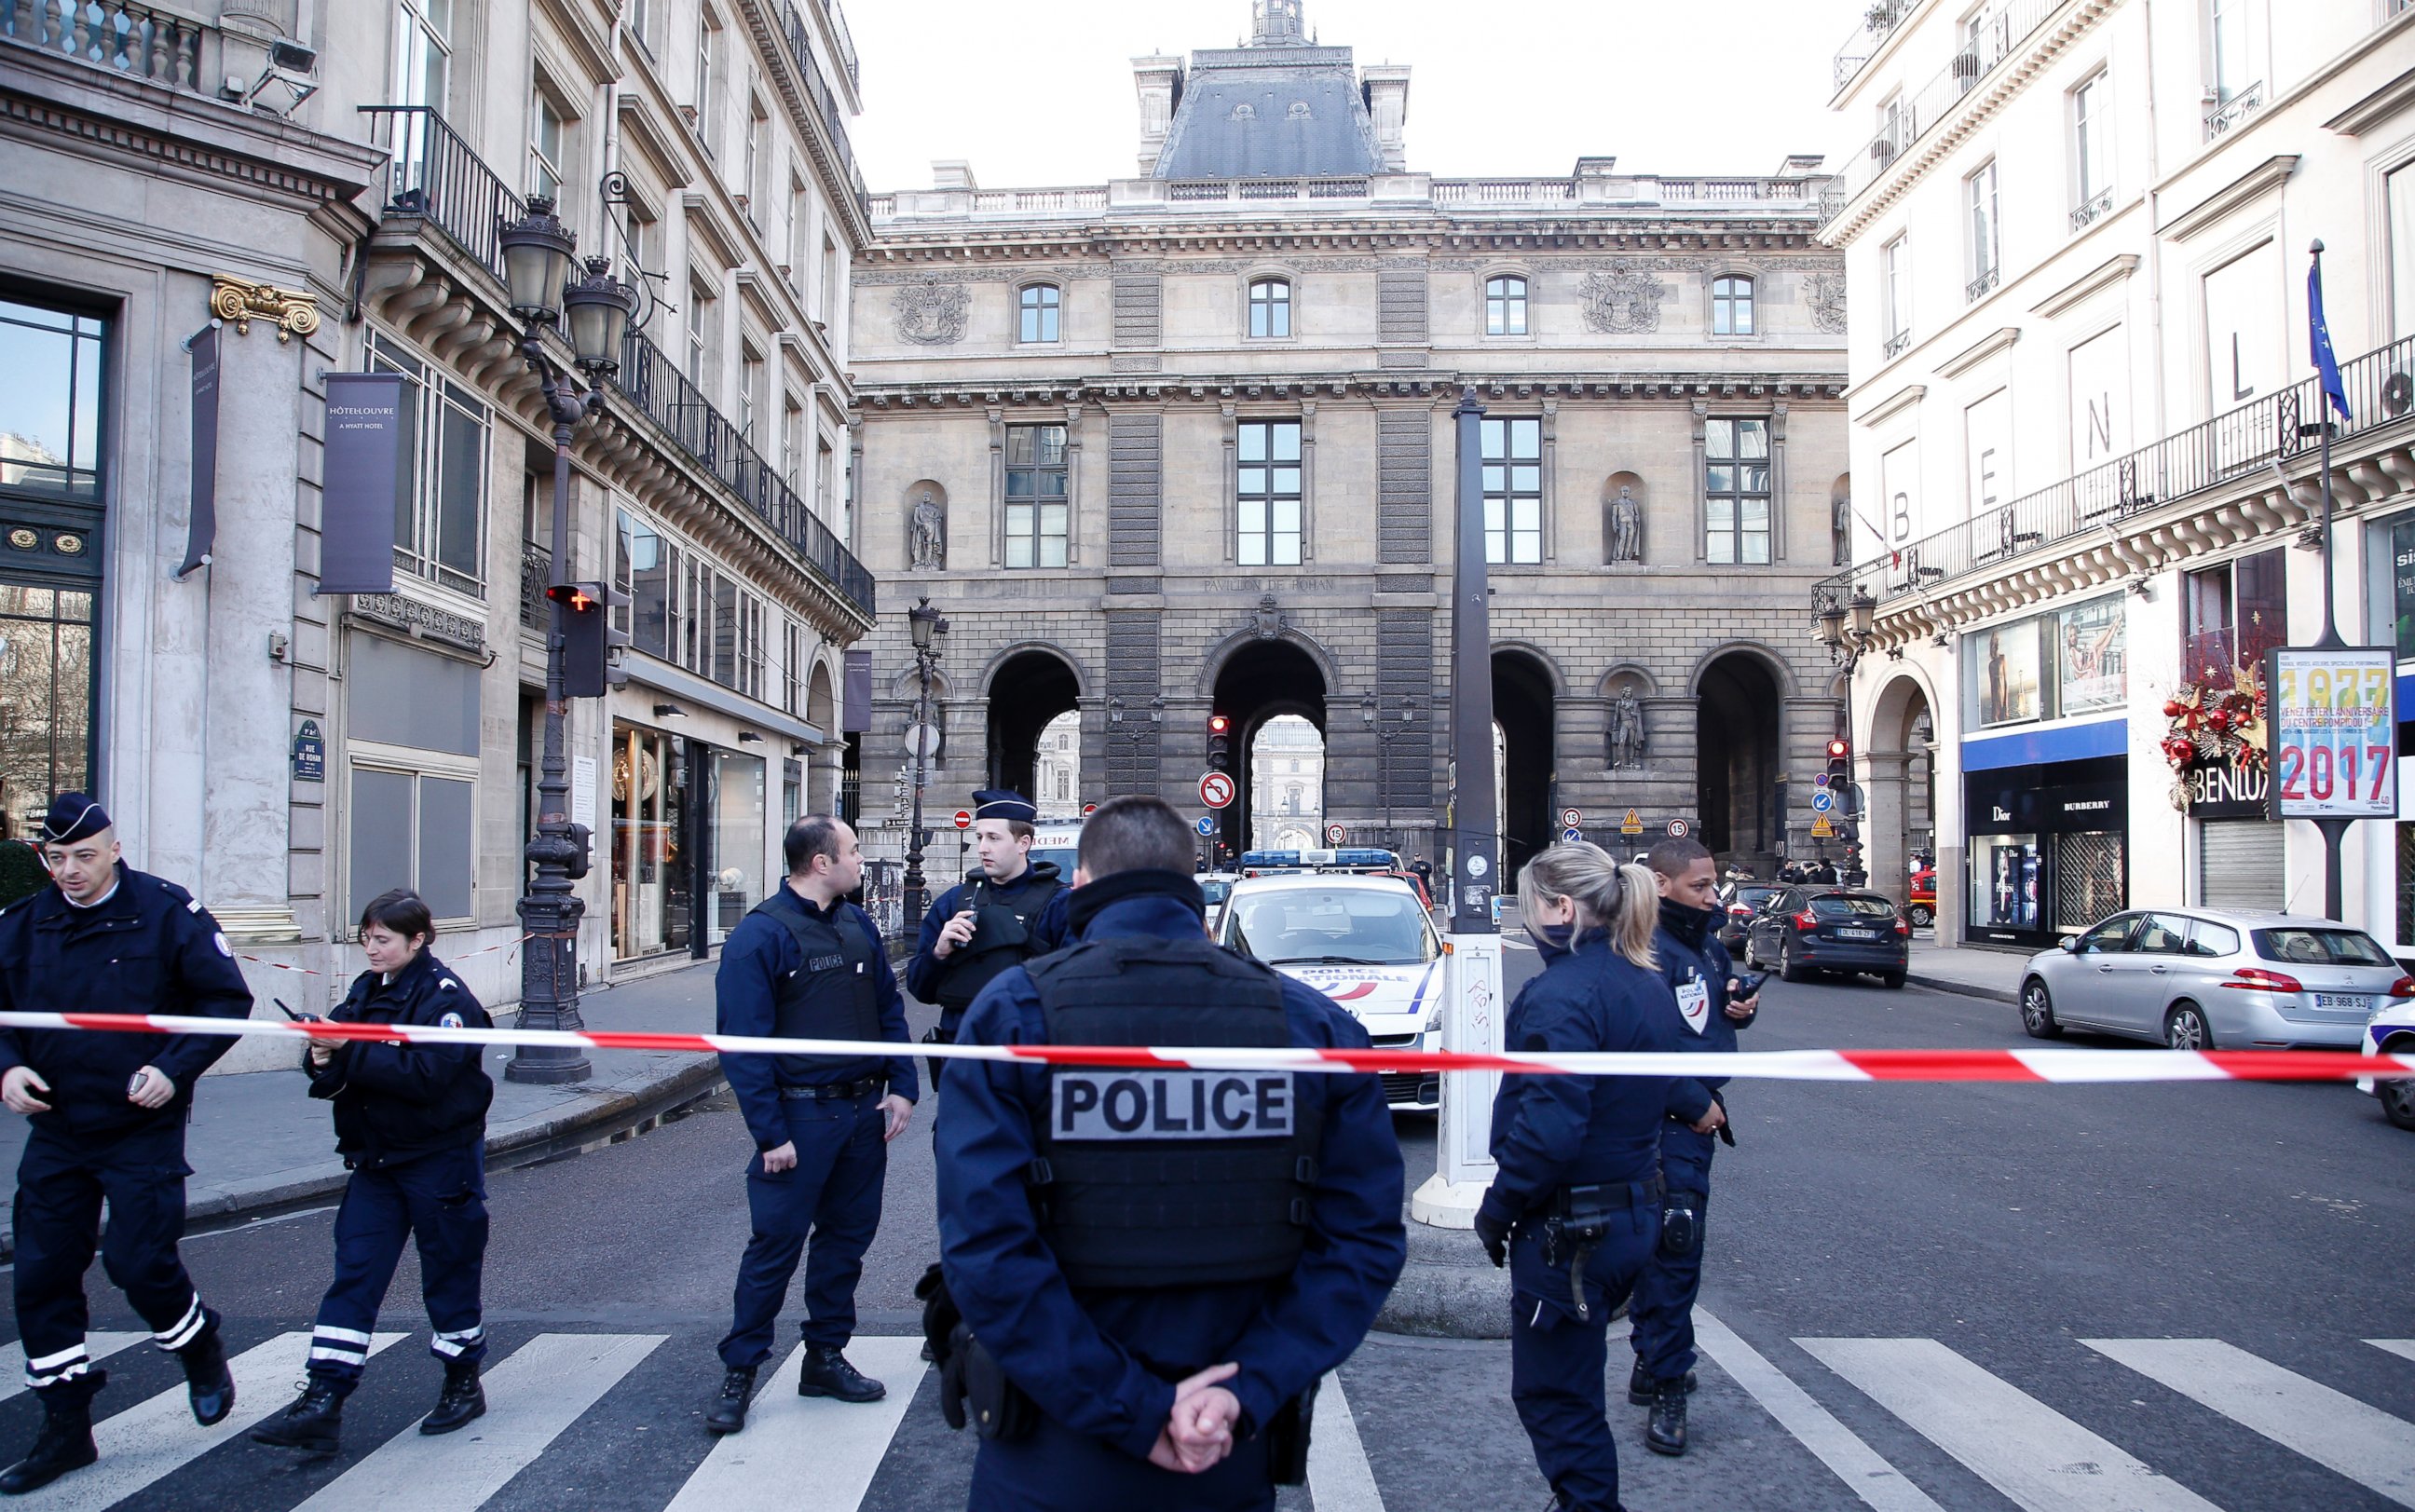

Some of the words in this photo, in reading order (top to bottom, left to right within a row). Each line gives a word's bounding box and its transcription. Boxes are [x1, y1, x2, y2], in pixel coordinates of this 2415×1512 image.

[2396, 549, 2415, 567] si
[1204, 579, 1261, 592] PAVILLON
[1268, 580, 1284, 591] DE
[1292, 579, 1334, 592] ROHAN
[2281, 707, 2304, 716] VENEZ
[2281, 717, 2291, 727] DU
[2293, 717, 2323, 727] CENTRE
[2324, 717, 2363, 727] POMPIDOU
[305, 744, 315, 753] RUE
[298, 752, 306, 760] DE
[306, 753, 321, 762] ROHAN
[2280, 745, 2390, 800] 2017
[2064, 800, 2110, 811] BURBERRY
[1567, 814, 1577, 823] 15
[1992, 806, 2011, 821] Dior
[1331, 829, 1341, 838] 15
[1672, 825, 1684, 834] 15
[812, 955, 842, 972] POLICE
[1297, 974, 1410, 983] ATIONALE
[1060, 1077, 1287, 1134] POLICE
